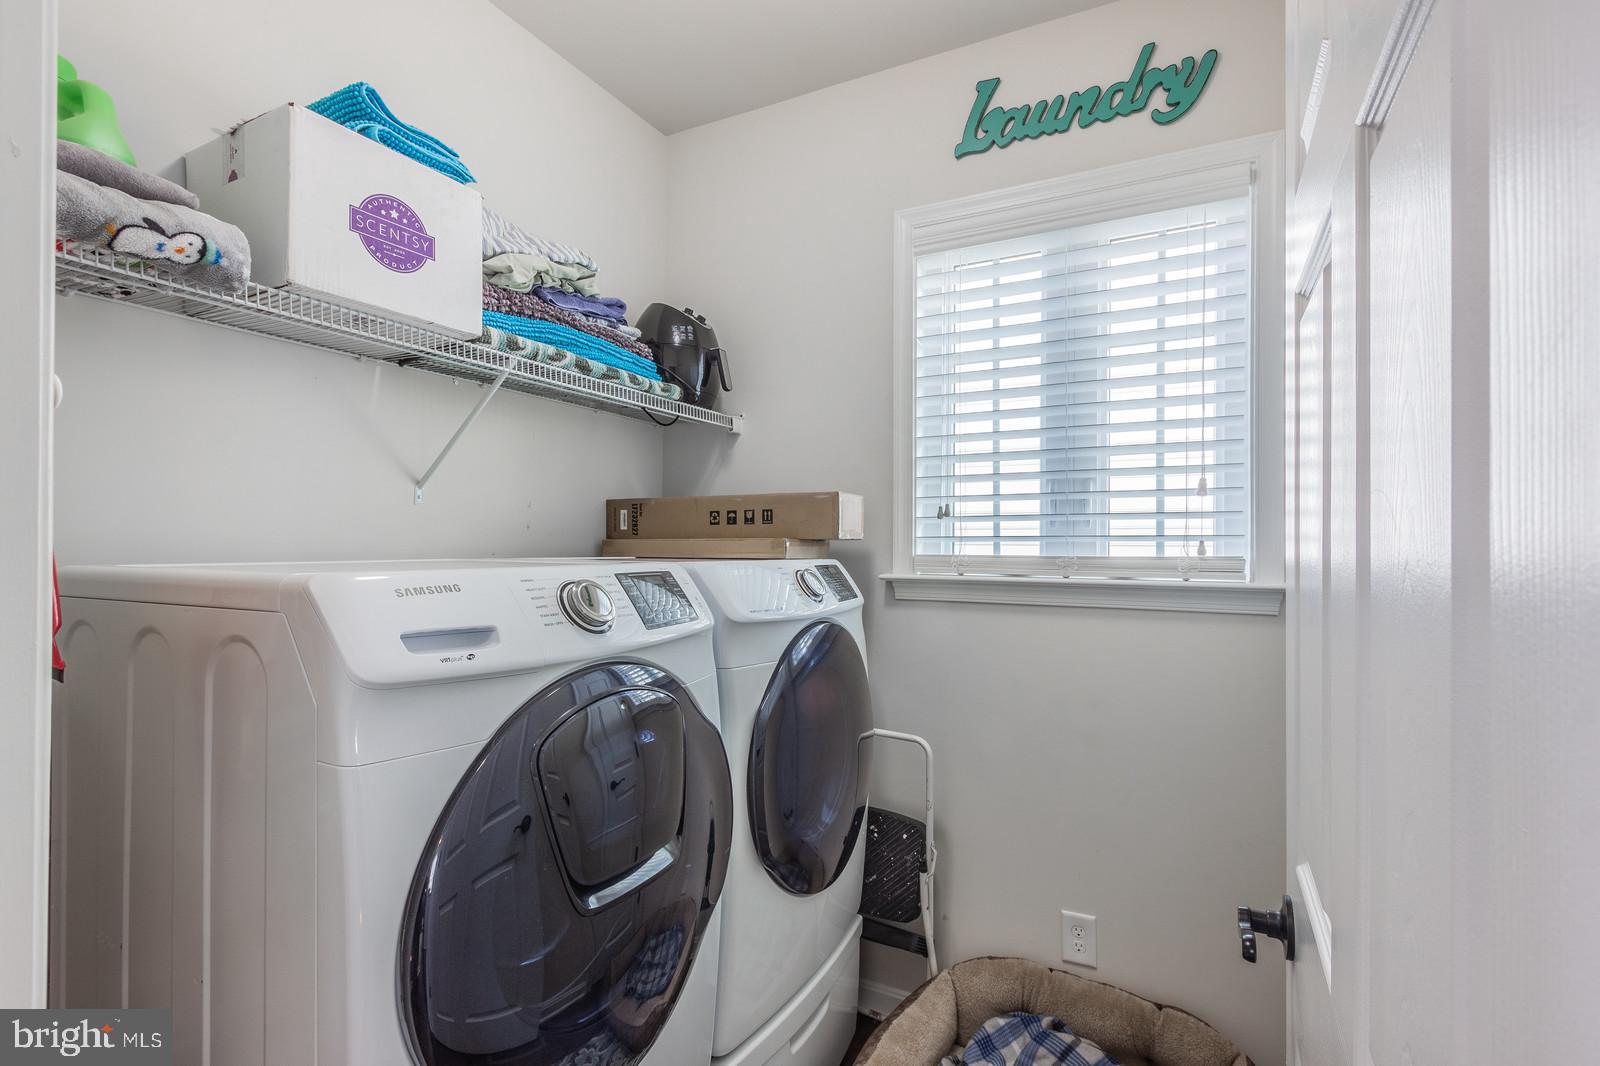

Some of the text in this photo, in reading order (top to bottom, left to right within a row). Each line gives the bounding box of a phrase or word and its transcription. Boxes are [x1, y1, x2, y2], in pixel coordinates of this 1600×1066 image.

[954, 42, 1217, 160] Laundry
[367, 199, 421, 229] AUTHENTIC
[356, 214, 430, 252] SCENTSY
[369, 245, 419, 270] PRODUCT
[394, 583, 462, 598] SAMSUNG
